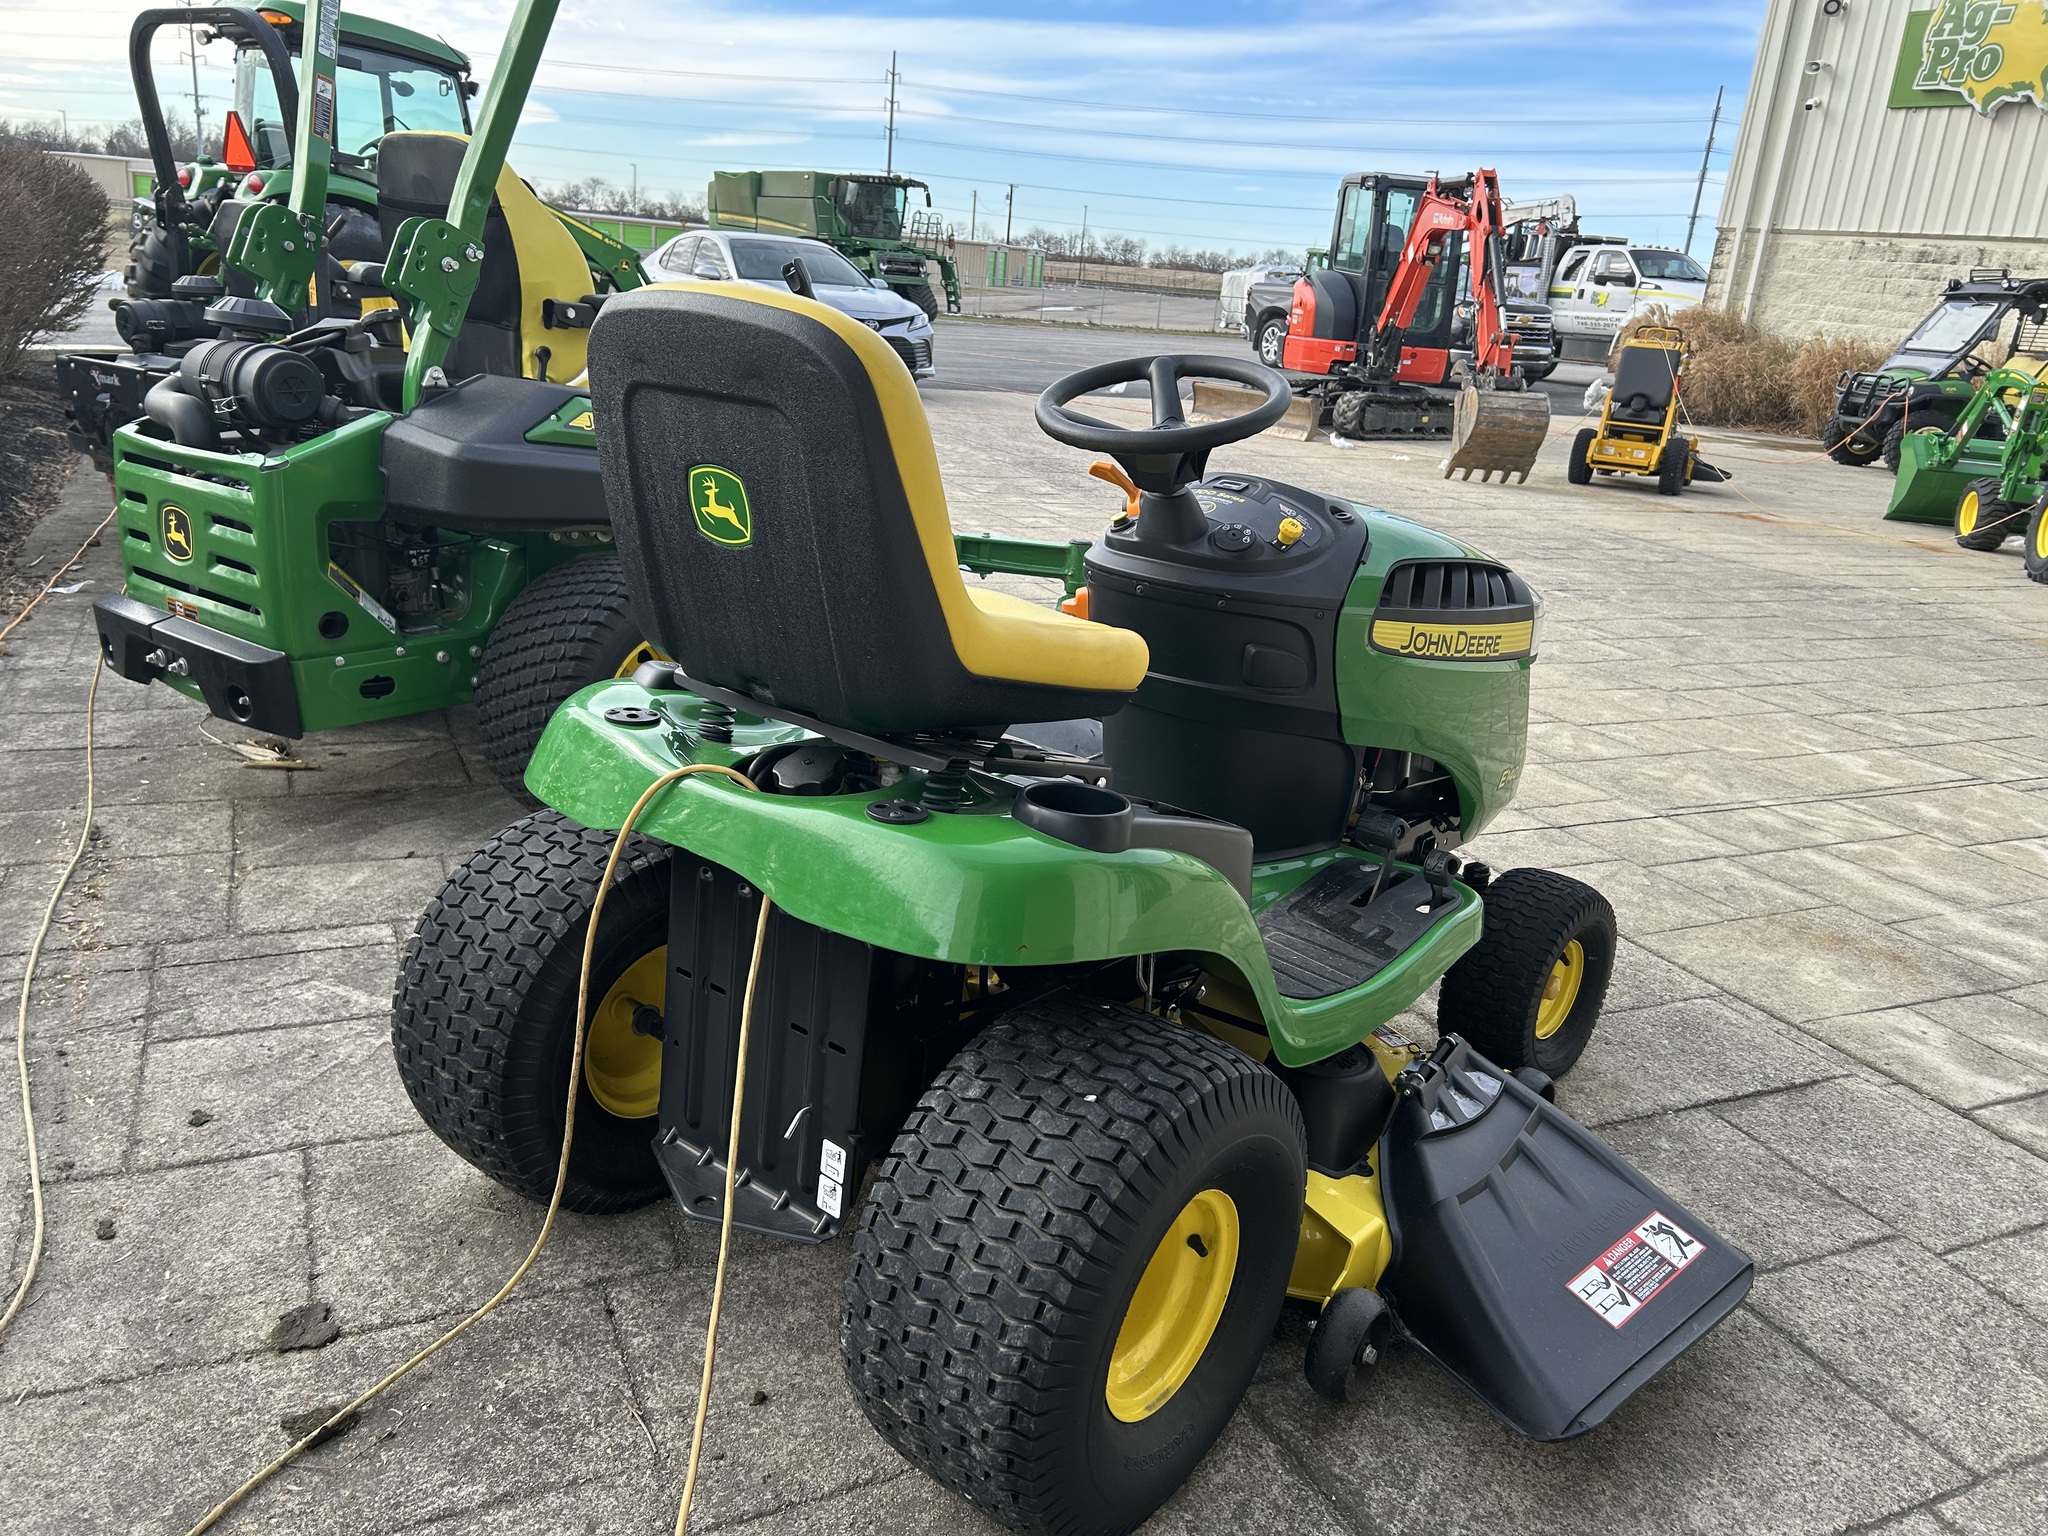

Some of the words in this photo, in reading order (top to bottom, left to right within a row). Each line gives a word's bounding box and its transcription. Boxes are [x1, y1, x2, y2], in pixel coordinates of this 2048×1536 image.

[1930, 0, 2016, 46] Ag-
[1917, 38, 2003, 86] Pro
[1577, 320, 1618, 328] 740-335-2071
[1400, 626, 1454, 654] JOHN
[1454, 630, 1502, 655] DEERE
[1606, 1237, 1636, 1261] DANGER
